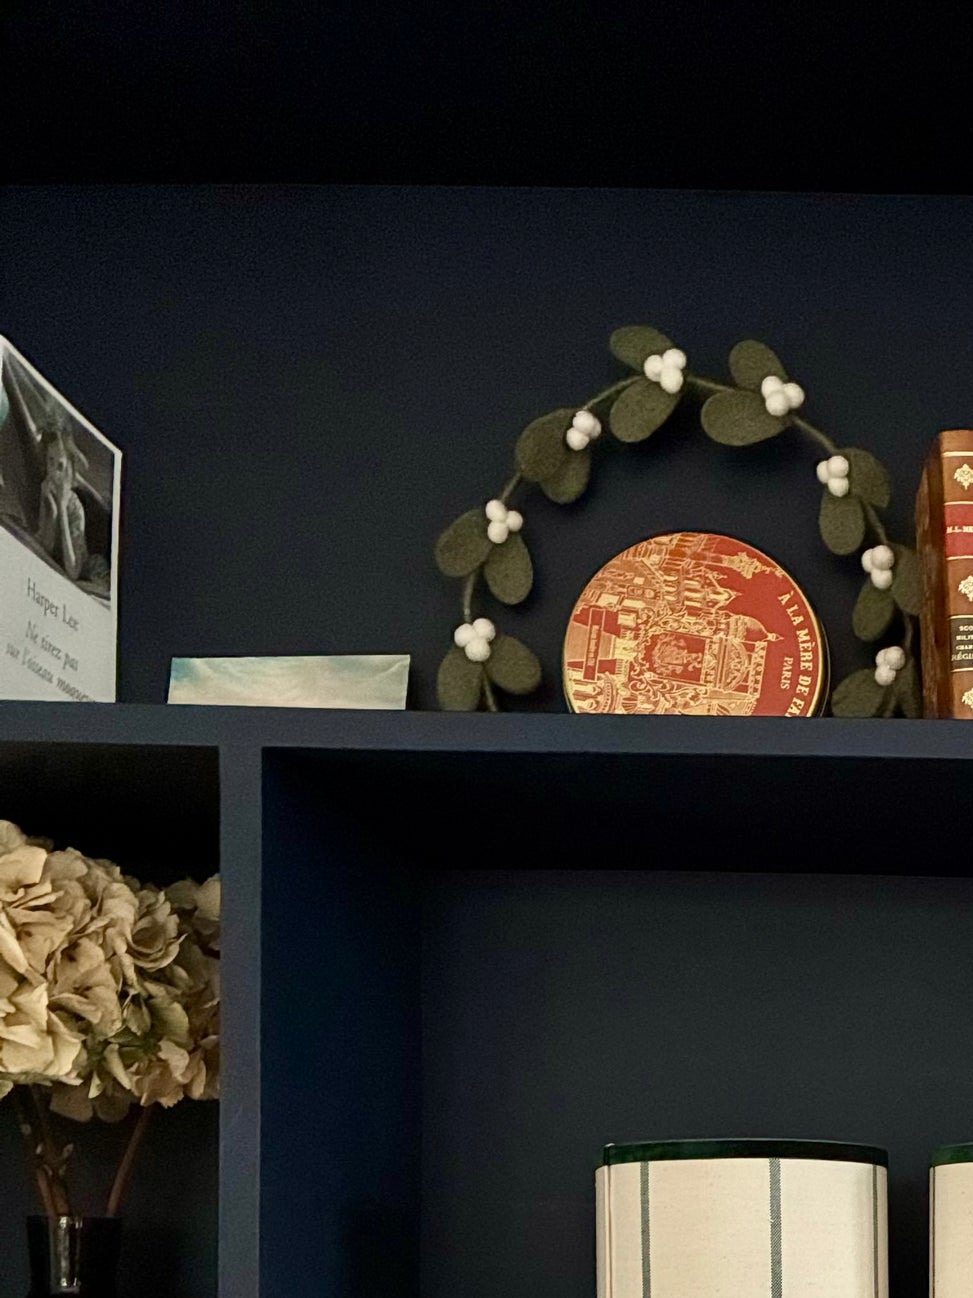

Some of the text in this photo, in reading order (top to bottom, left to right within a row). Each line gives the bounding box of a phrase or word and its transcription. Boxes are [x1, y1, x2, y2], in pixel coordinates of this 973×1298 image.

[27, 577, 80, 631] Harper Lee
[25, 620, 79, 671] Ne tirez pas
[777, 591, 816, 696] À LA MÈRE DE
[780, 656, 794, 690] PARIS
